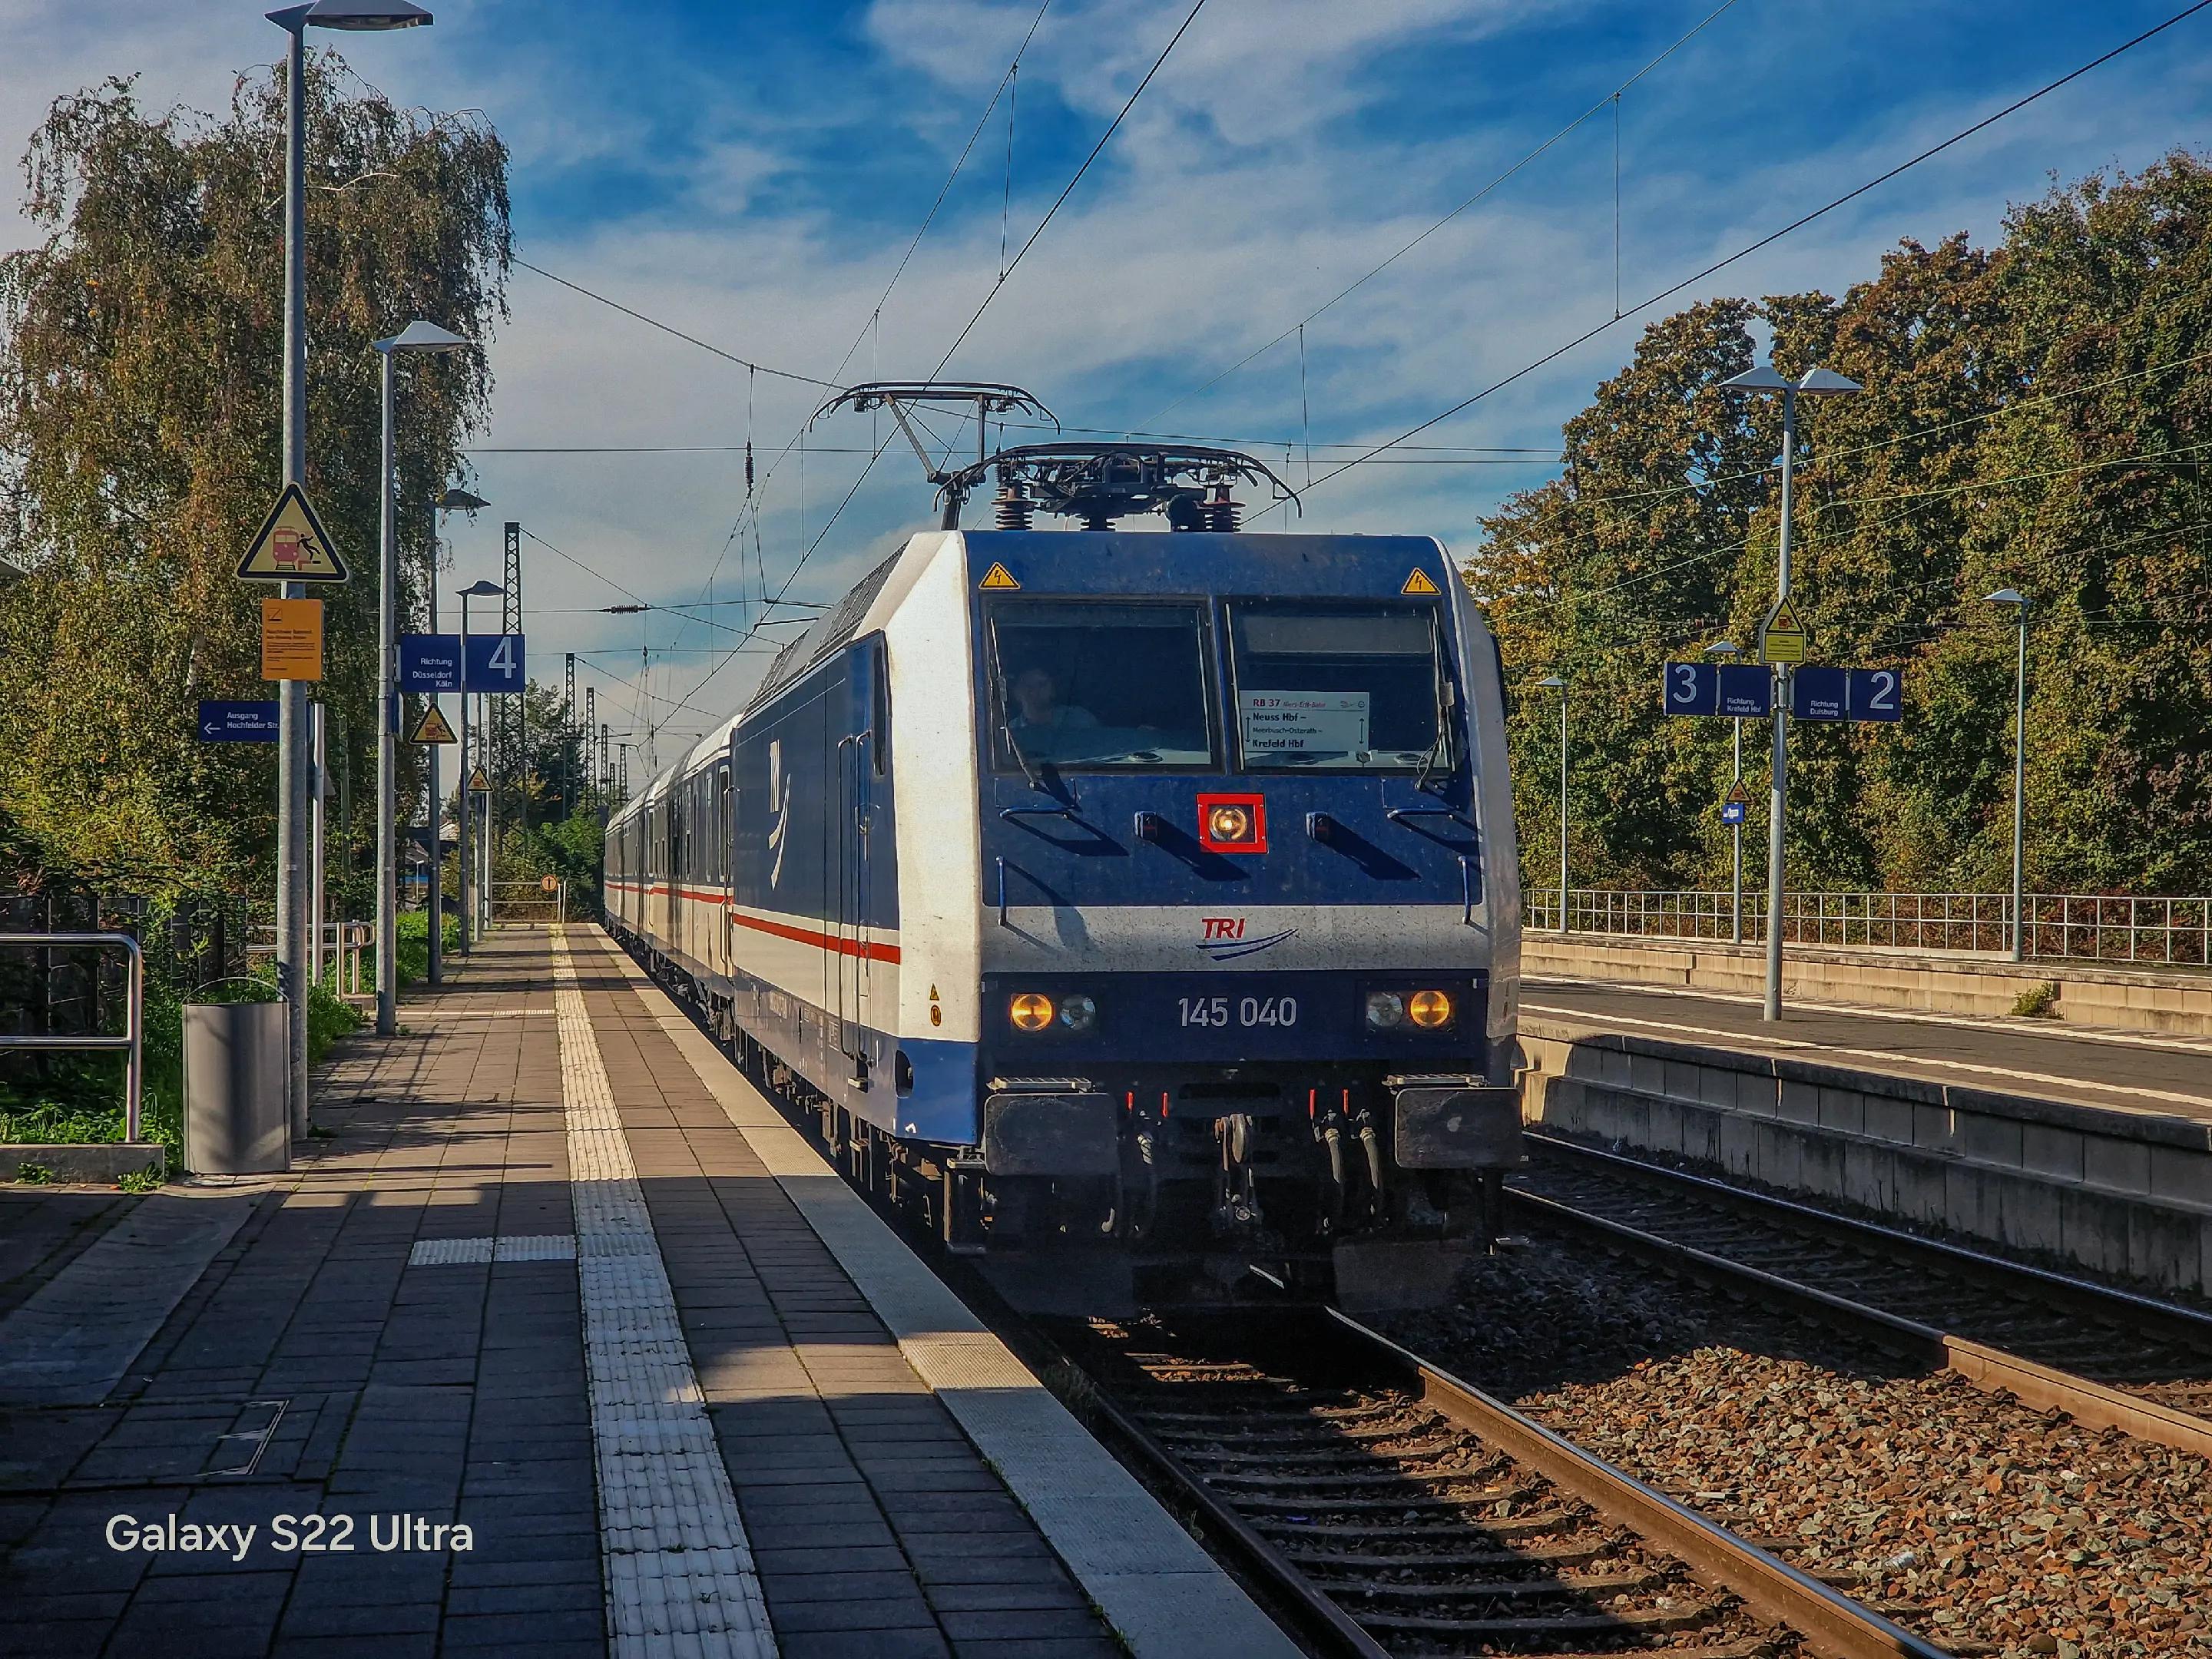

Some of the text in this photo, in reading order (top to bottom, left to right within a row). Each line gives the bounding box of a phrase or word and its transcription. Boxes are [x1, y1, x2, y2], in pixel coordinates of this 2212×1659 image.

[420, 657, 452, 667] Richtung
[488, 636, 517, 679] 4
[412, 671, 452, 679] Düsseldorf
[1673, 664, 1697, 704] 3
[1869, 671, 1894, 710] 2
[1253, 698, 1266, 707] RB
[1727, 697, 1755, 706] Richtung
[1810, 700, 1839, 709] Richtung
[227, 711, 259, 720] Ausgang
[1810, 708, 1839, 717] Duisburg
[1253, 713, 1280, 721] Neuss
[1282, 714, 1300, 722] Hbf
[1252, 739, 1305, 748] Krefeld Hbf
[1200, 917, 1246, 939] TRI
[1178, 997, 1297, 1027] 145 040
